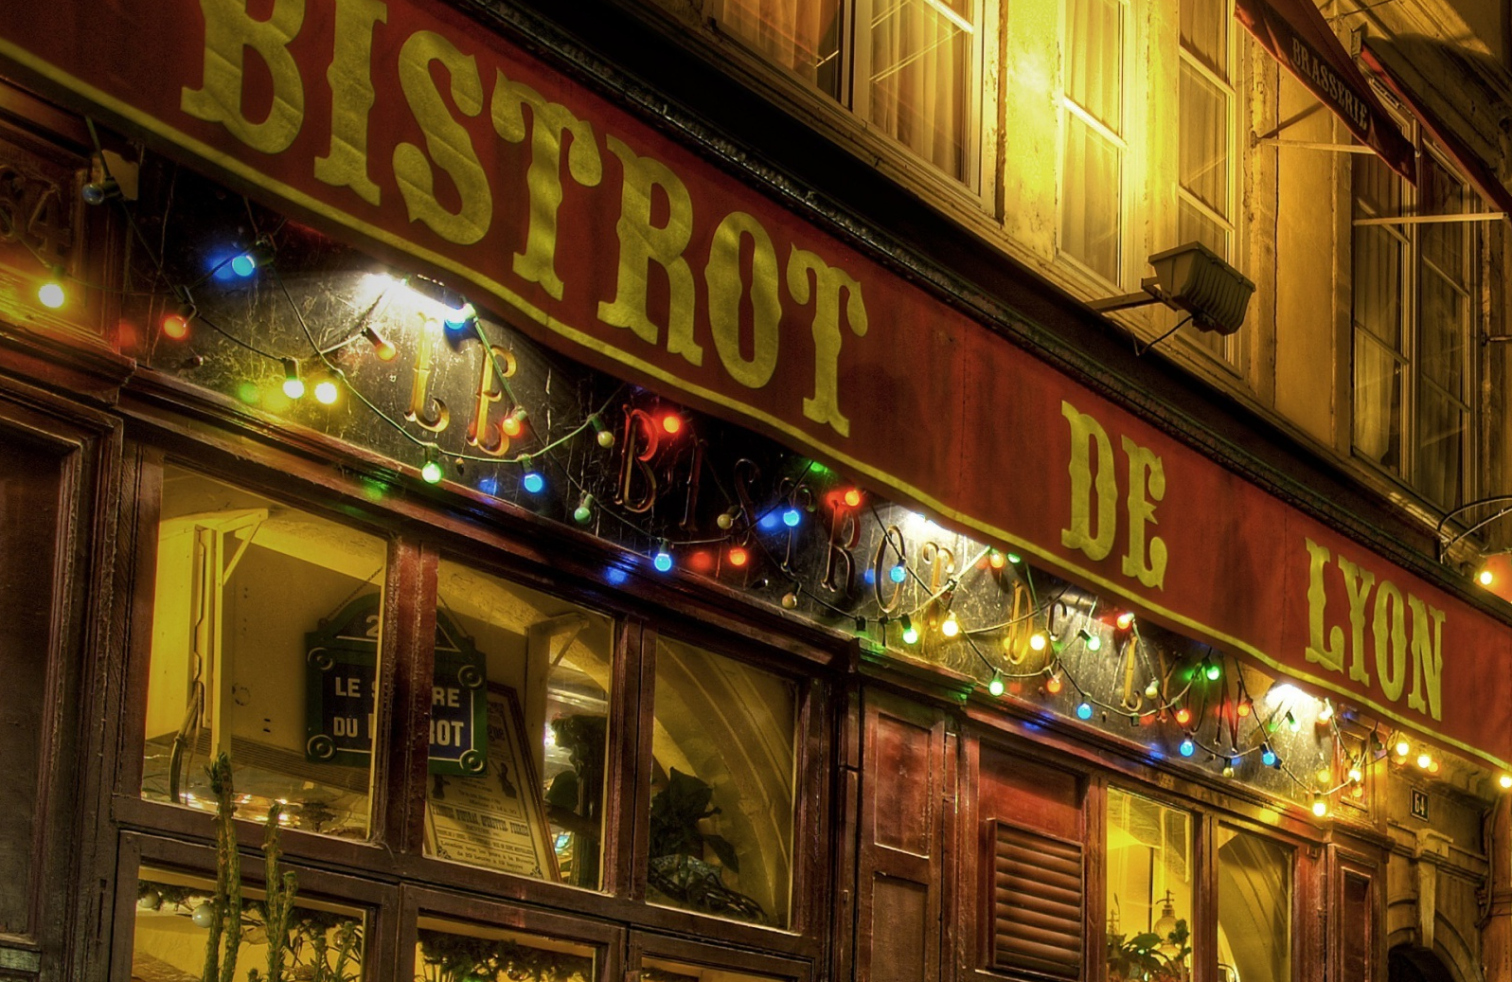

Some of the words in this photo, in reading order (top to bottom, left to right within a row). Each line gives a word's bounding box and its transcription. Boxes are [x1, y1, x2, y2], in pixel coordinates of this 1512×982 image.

[1292, 38, 1368, 131] BRASSERIE
[181, 0, 869, 438] BISTROT
[1061, 400, 1169, 592] DE
[1305, 537, 1447, 721] LYON
[335, 677, 361, 698] LE
[333, 716, 358, 738] DU
